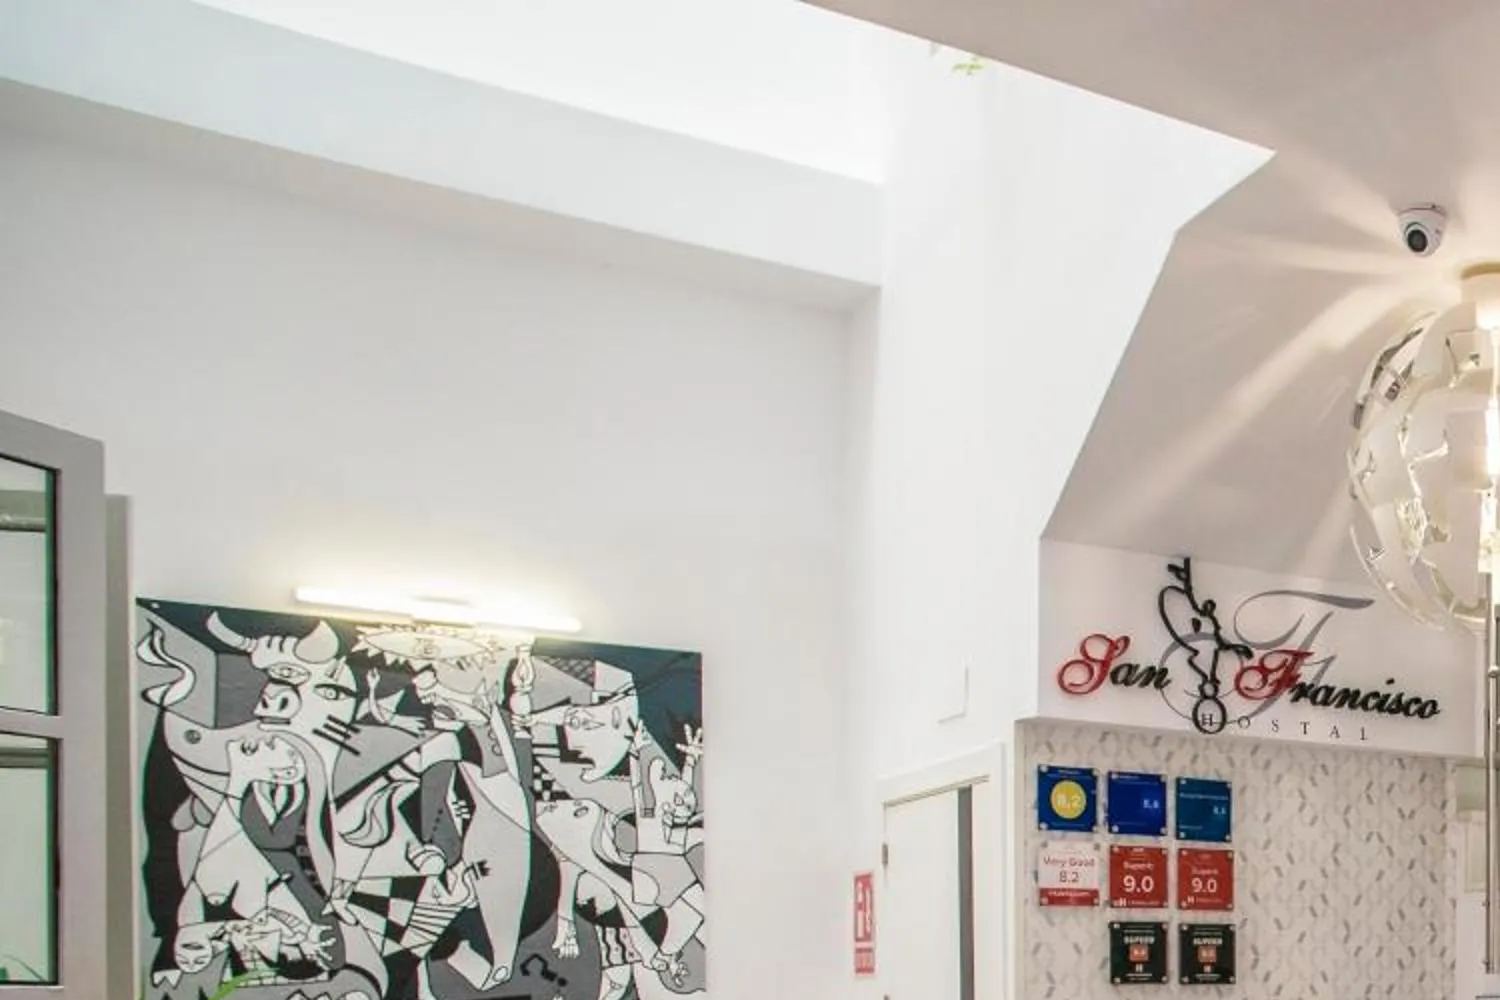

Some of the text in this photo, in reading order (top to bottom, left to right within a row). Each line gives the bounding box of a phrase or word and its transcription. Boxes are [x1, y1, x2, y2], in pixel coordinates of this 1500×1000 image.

[1058, 633, 1441, 720] San Francisco
[1200, 712, 1369, 742] HOSTAL
[1123, 875, 1155, 893] 9.0
[1191, 877, 1218, 894] 9.0
